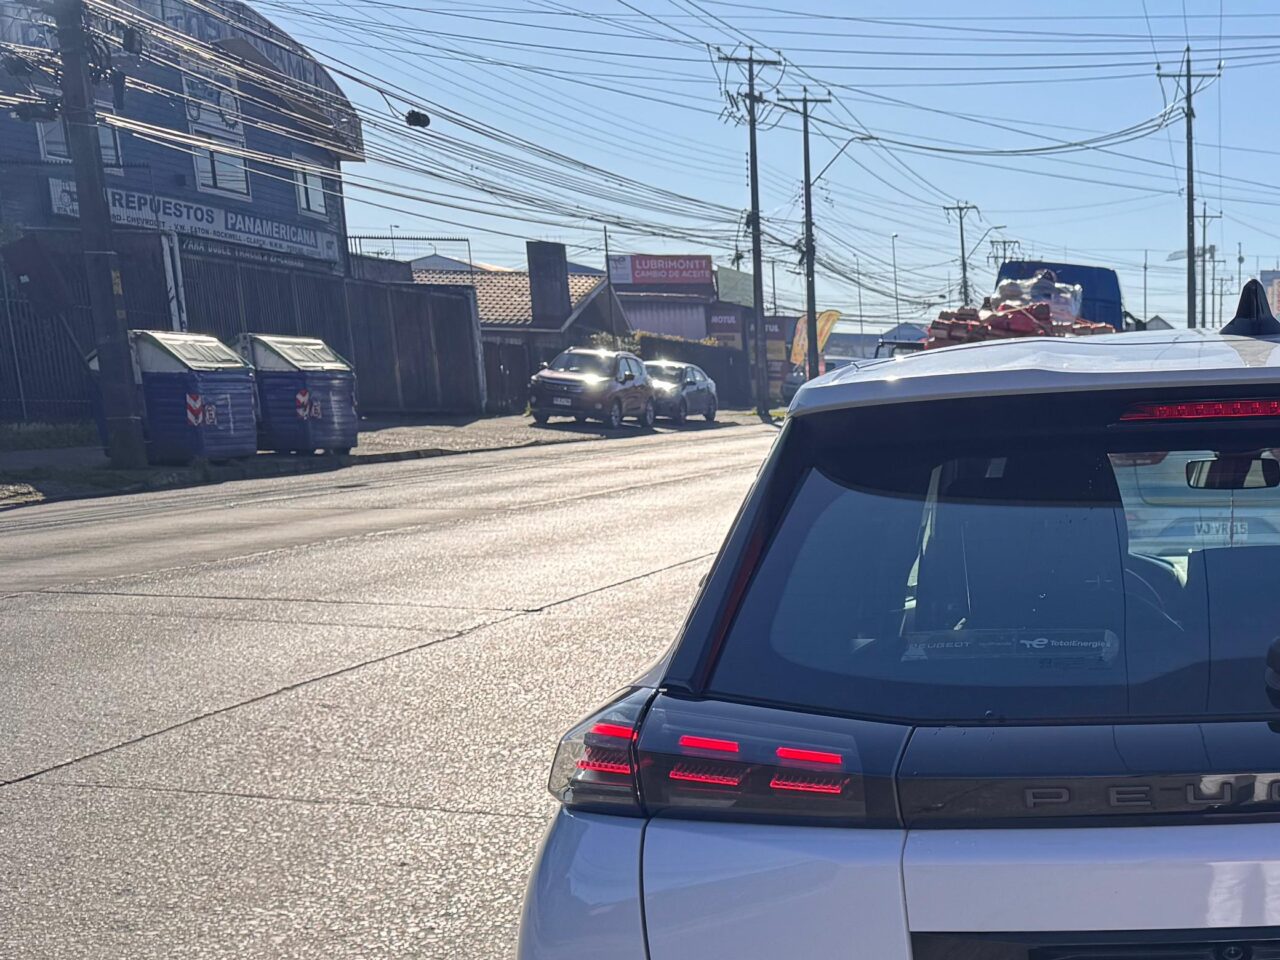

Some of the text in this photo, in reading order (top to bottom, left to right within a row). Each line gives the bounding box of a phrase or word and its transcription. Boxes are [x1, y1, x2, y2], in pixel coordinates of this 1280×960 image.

[111, 191, 215, 225] REPUESTOS
[227, 212, 317, 246] PANAMERICANA
[711, 315, 737, 324] MOTUL
